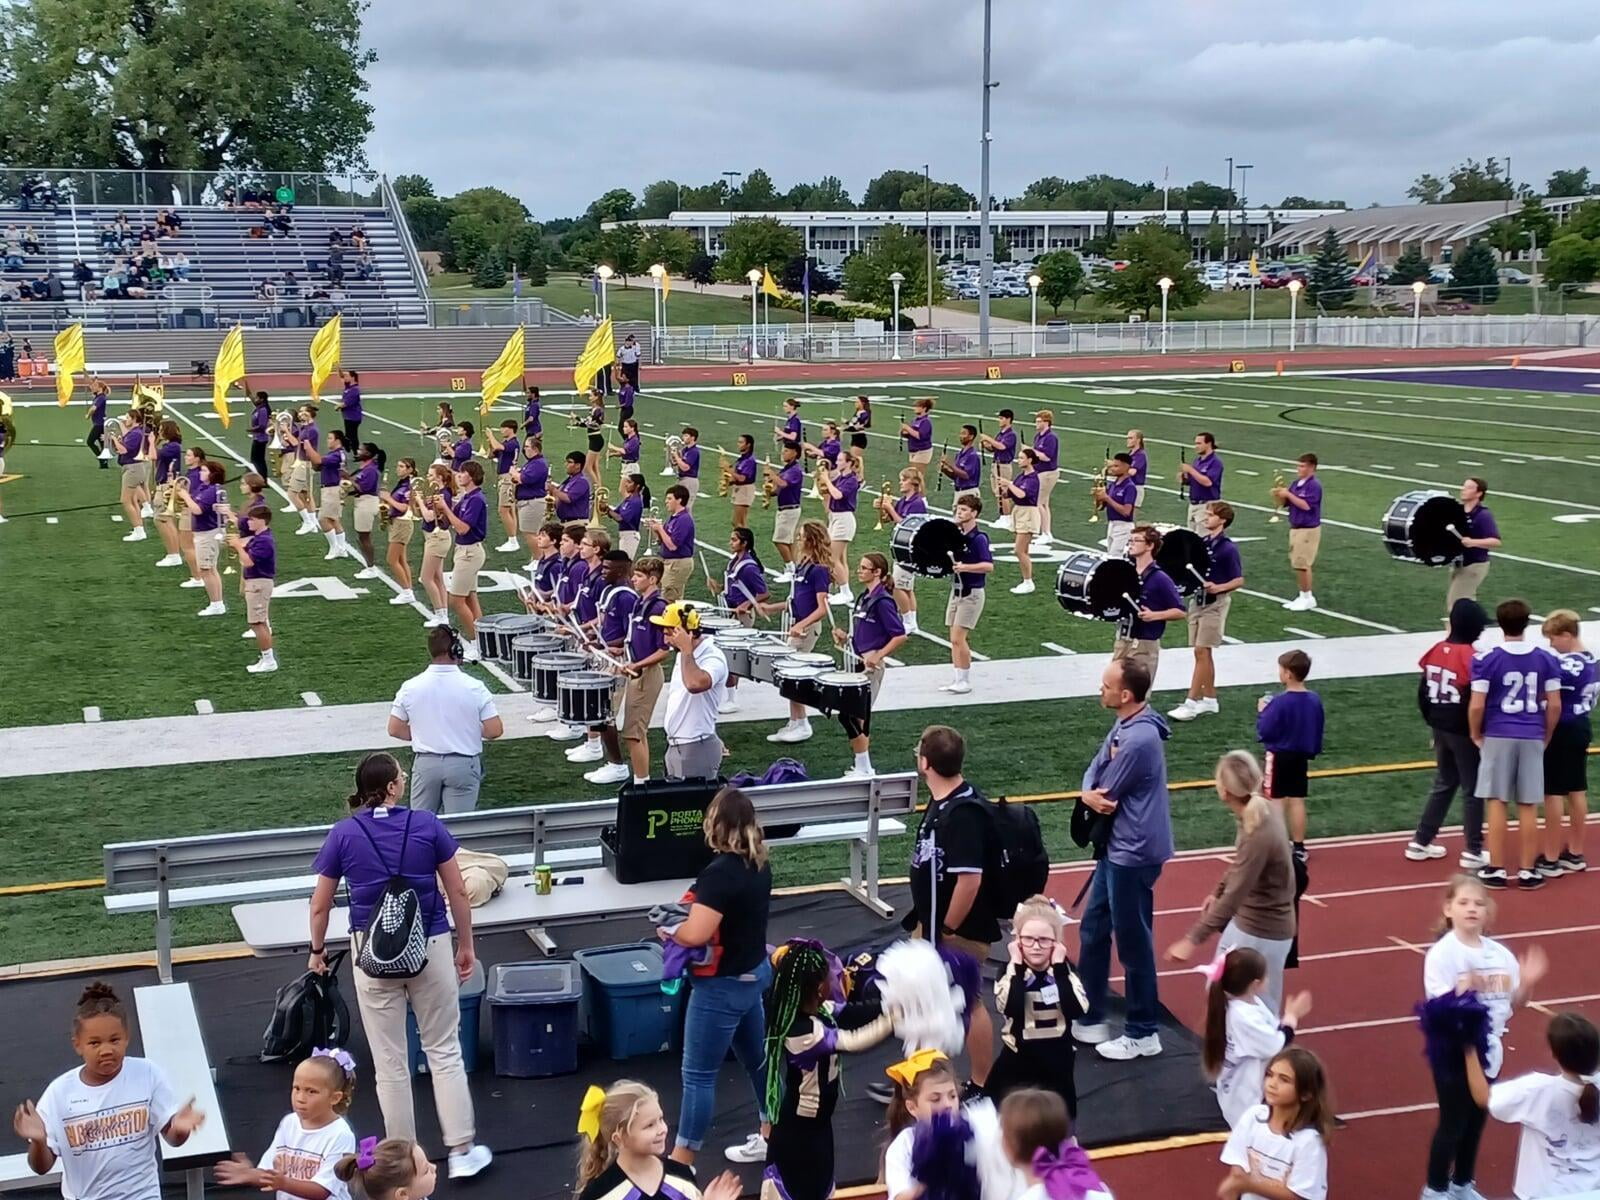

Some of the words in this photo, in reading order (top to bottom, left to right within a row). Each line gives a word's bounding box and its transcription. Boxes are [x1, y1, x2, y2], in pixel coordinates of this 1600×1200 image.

[1425, 664, 1461, 704] 55
[1501, 671, 1539, 714] 21
[670, 816, 703, 825] PHONE
[671, 809, 704, 819] PORTA
